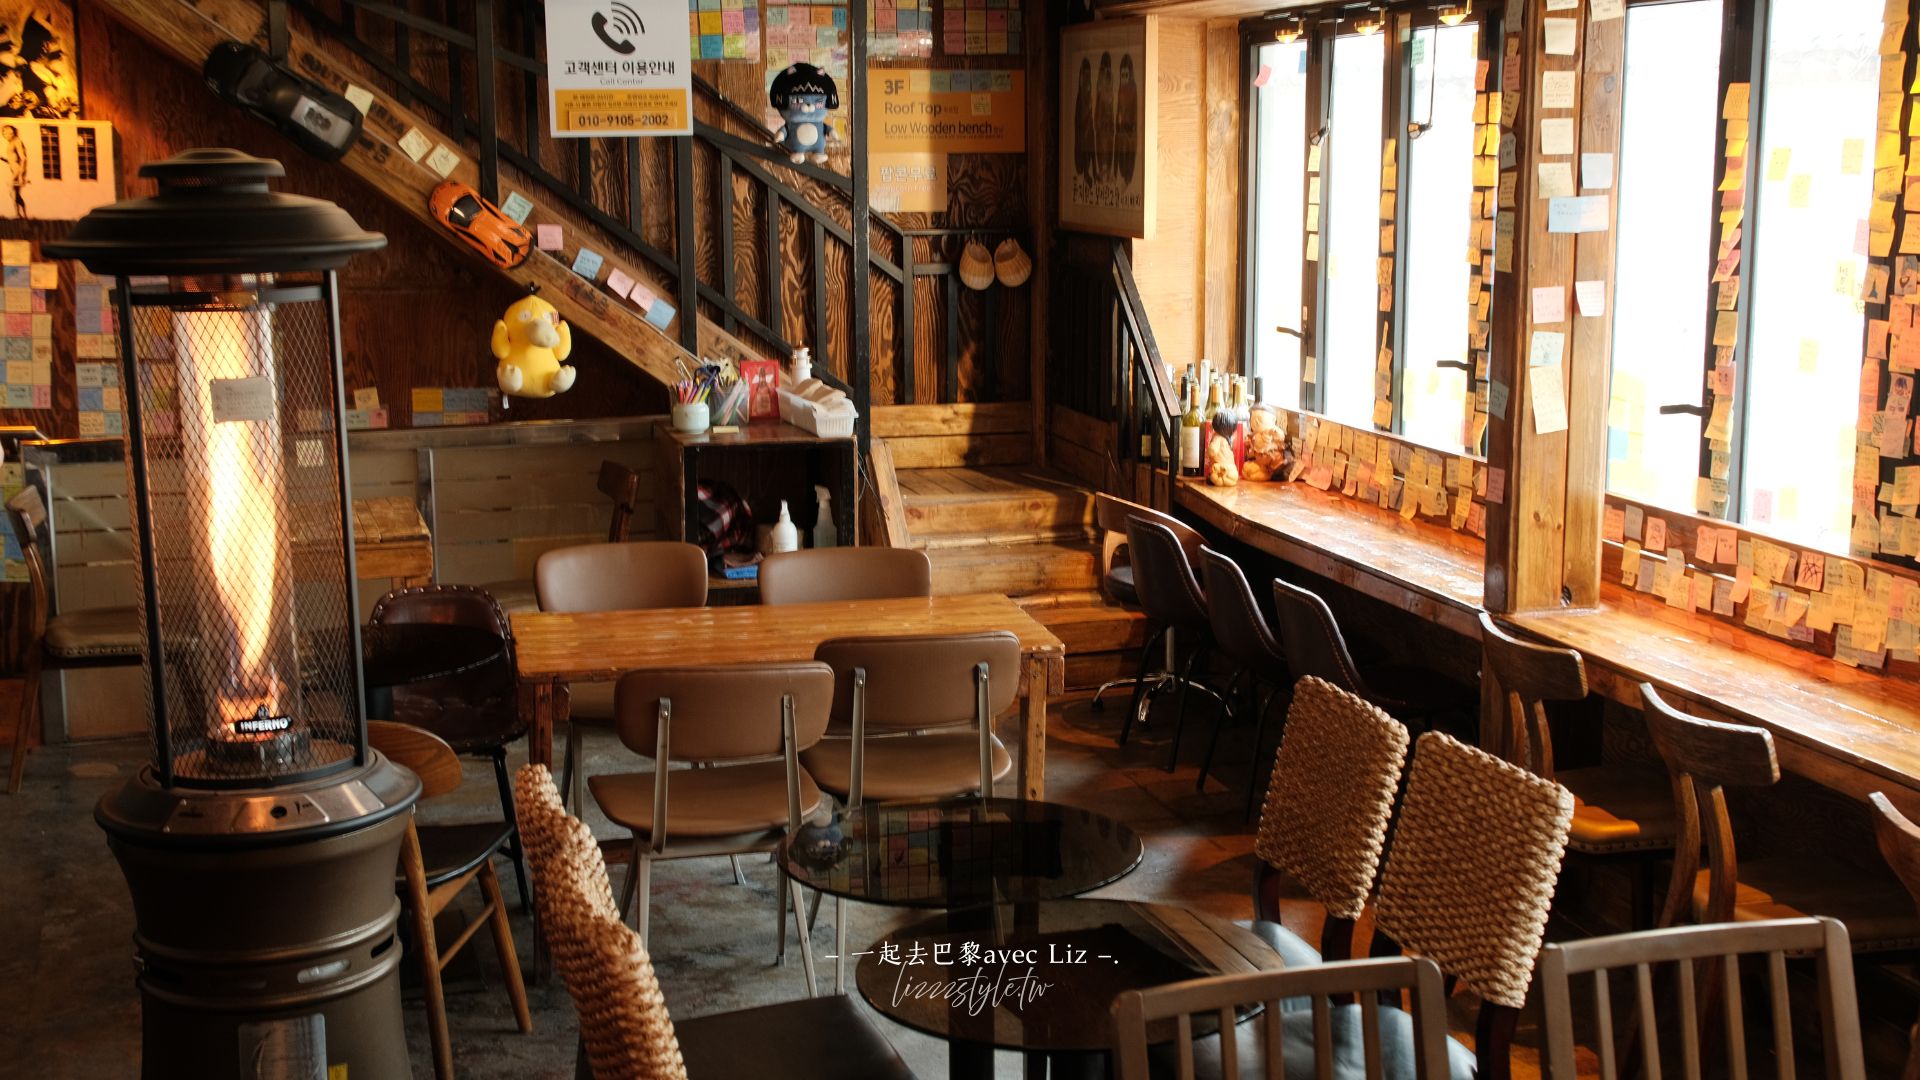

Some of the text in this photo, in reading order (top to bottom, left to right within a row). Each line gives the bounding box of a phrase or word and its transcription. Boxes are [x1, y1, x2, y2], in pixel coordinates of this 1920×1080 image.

[564, 60, 675, 75] 고객센터 이용안내
[884, 80, 904, 95] 3F
[884, 102, 915, 115] Roof
[919, 102, 942, 117] Top
[578, 114, 669, 126] 010-9105-2002
[884, 122, 907, 134] Low
[910, 122, 956, 134] Wooden
[958, 122, 992, 134] bench
[240, 718, 288, 731] INFERNO
